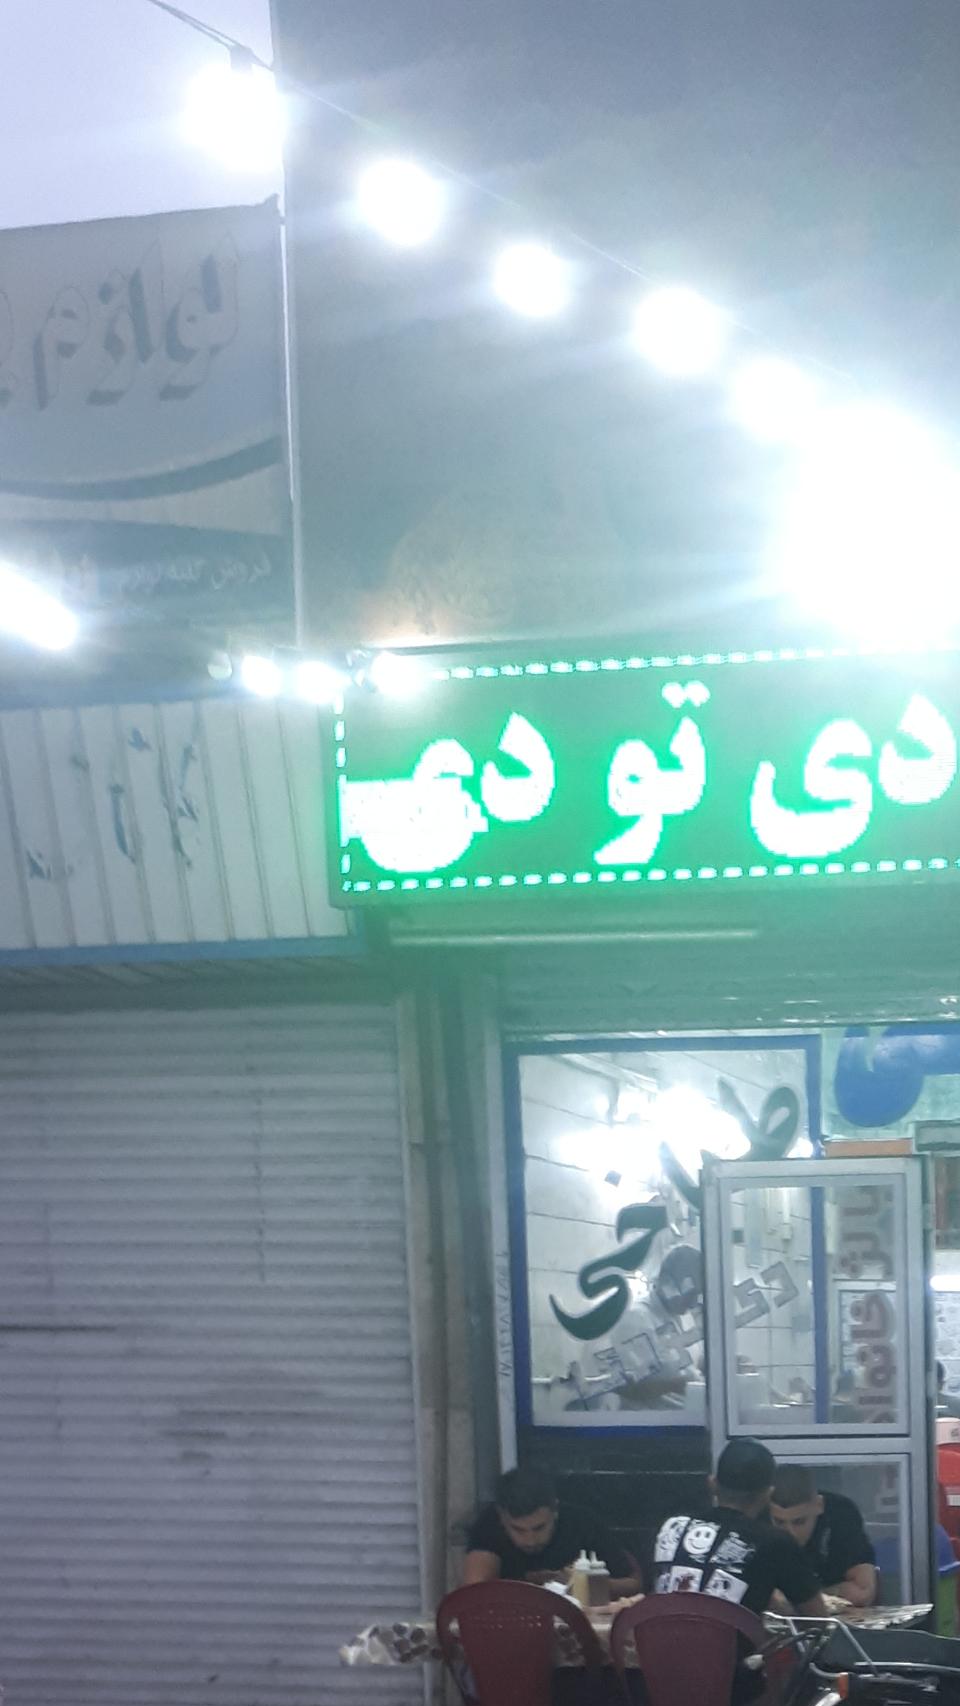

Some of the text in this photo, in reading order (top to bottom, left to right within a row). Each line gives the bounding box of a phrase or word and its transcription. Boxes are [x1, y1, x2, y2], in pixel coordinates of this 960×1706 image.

[355, 711, 556, 872] دی
[594, 681, 710, 865] تو
[750, 692, 957, 858] دی
